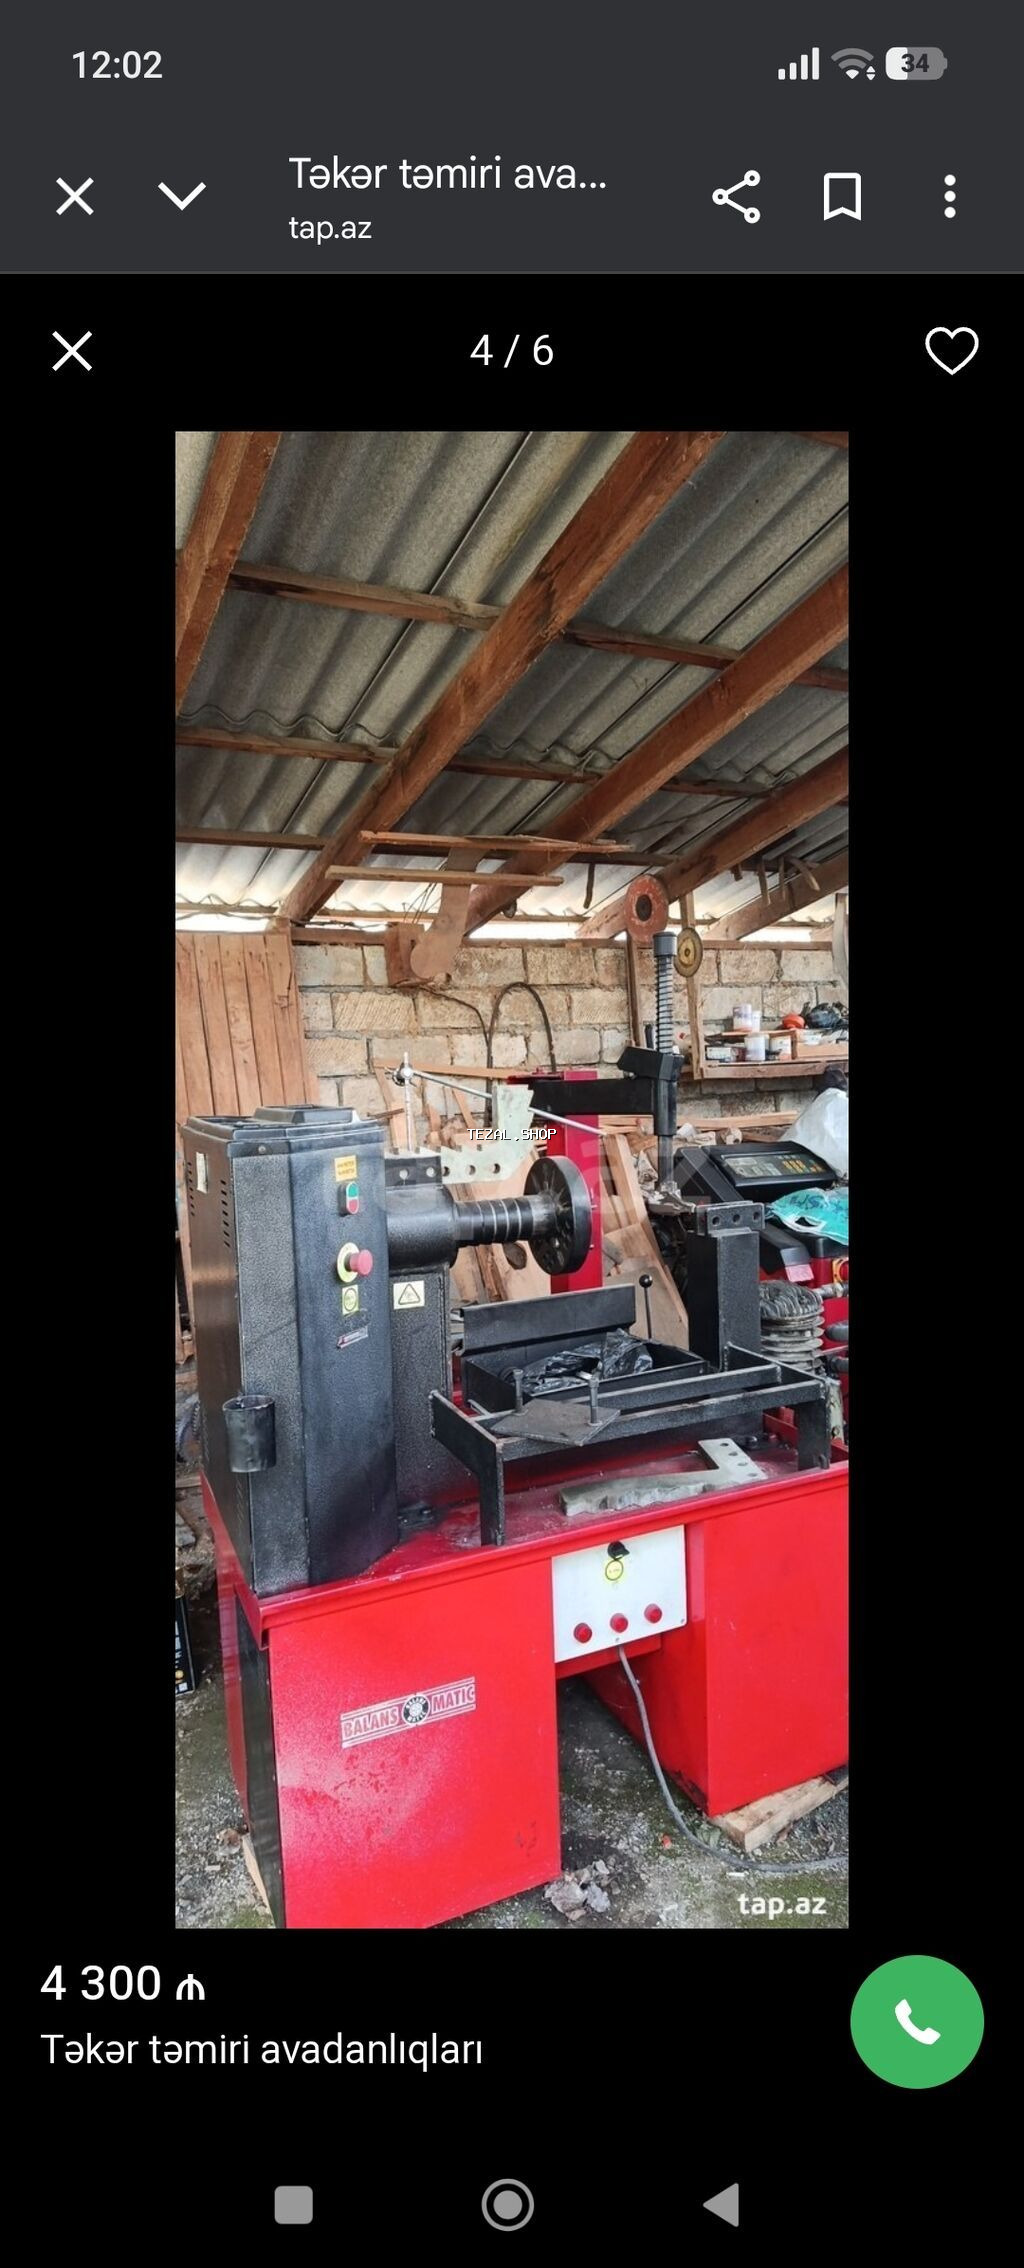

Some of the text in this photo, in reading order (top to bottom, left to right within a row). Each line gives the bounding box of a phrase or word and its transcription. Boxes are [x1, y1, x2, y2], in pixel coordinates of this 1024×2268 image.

[72, 51, 163, 79] 12:02
[901, 53, 930, 73] 34
[288, 154, 607, 190] Təkər təmiri ava...
[288, 216, 372, 246] tap.az
[469, 334, 494, 366] 4
[533, 334, 554, 366] 6
[343, 1685, 475, 1738] BALANS MATIC
[40, 1964, 67, 2001] 4
[81, 1964, 161, 2001] 300
[40, 2031, 482, 2073] Təkər təmiri avadanlıqları
